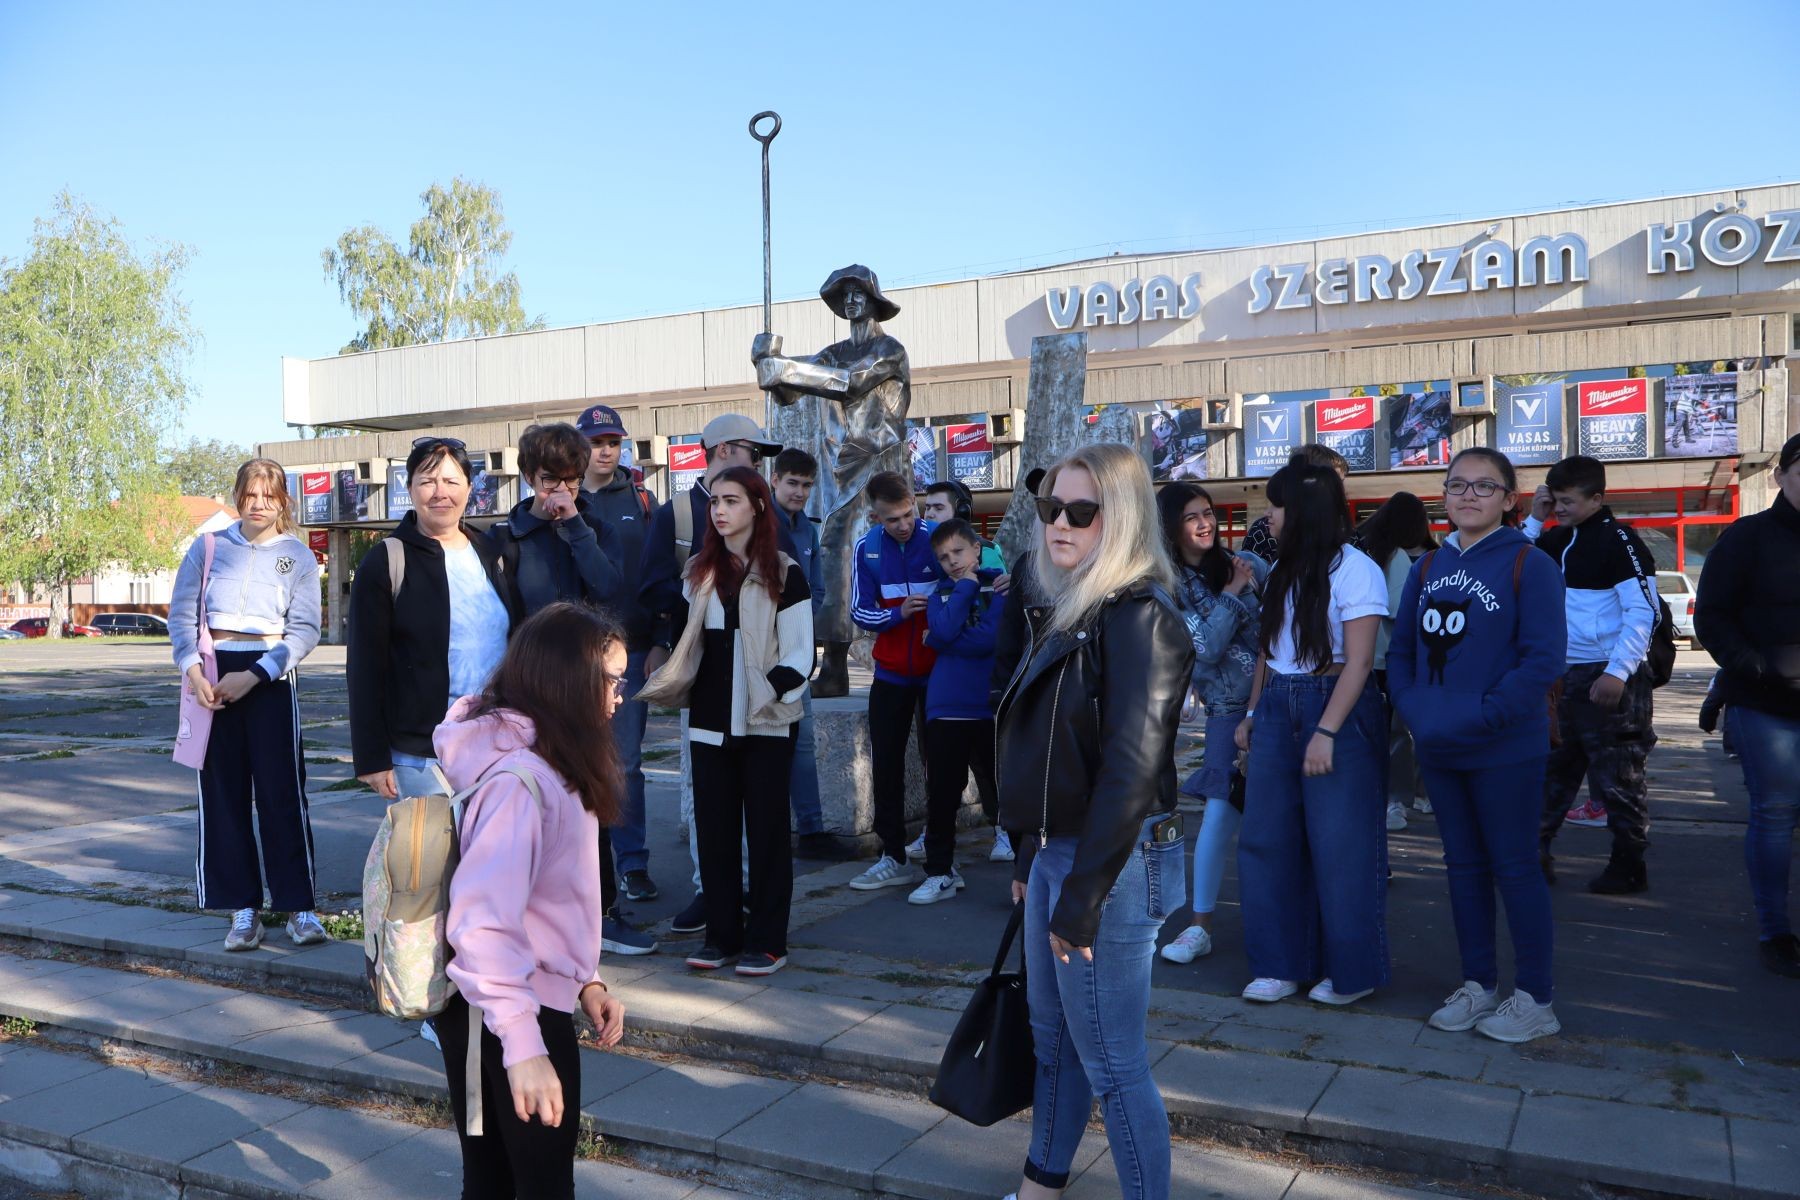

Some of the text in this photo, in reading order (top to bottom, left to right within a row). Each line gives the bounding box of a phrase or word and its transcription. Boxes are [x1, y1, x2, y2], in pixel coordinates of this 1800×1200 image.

[1046, 199, 1800, 330] VASAS SZERSZÁM KÖZ
[1586, 384, 1639, 406] Milwaukee
[1322, 402, 1367, 422] Milwaukee
[1589, 418, 1638, 434] HEAVY
[951, 428, 987, 445] Milwaukee
[1325, 434, 1366, 448] HEAVY
[1508, 430, 1551, 445] VASAS
[1589, 431, 1638, 444] DUTY
[1255, 445, 1292, 458] VASAS
[1332, 446, 1366, 457] UTY
[954, 457, 986, 468] HEAVY
[954, 467, 987, 477] DUTY
[307, 505, 329, 514] DUTY
[1467, 579, 1501, 612] puss
